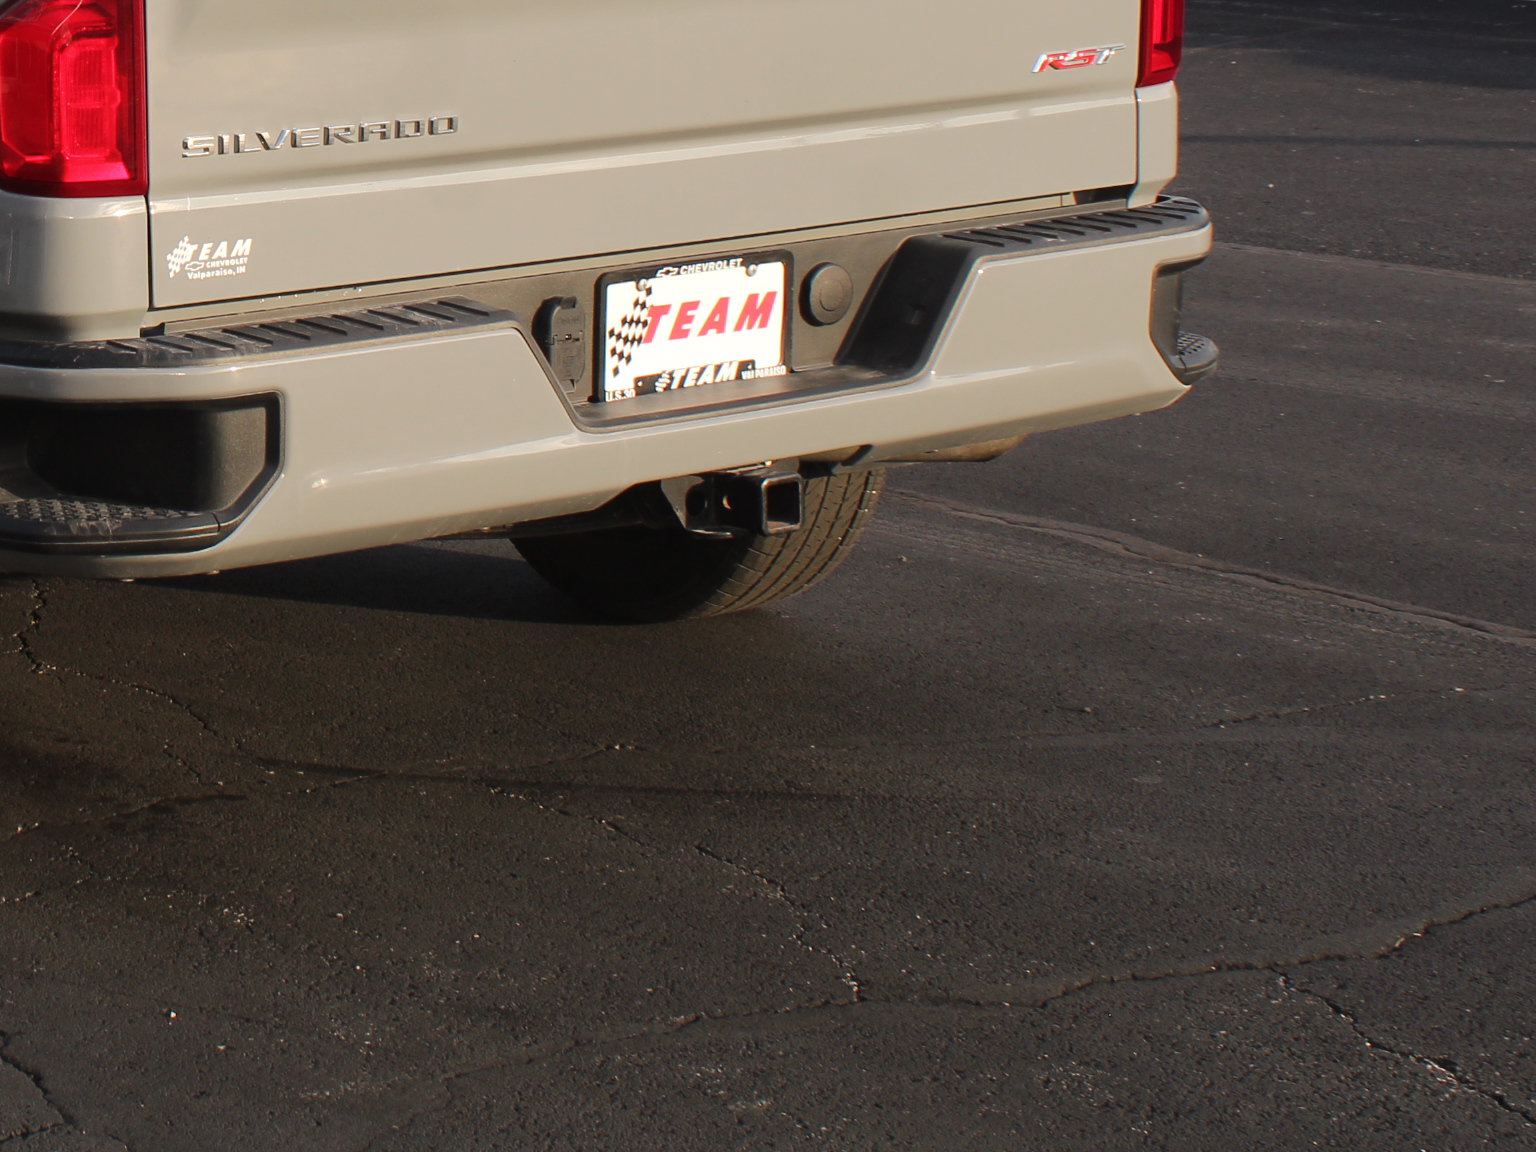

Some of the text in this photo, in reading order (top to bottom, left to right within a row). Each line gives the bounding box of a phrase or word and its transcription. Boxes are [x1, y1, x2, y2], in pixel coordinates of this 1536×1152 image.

[1031, 43, 1126, 73] RST
[181, 114, 459, 159] SILVERADO
[181, 239, 252, 262] TEAM
[206, 257, 248, 268] CHEVROLET
[679, 258, 744, 276] CHEVROLET
[643, 291, 777, 343] TEAM
[670, 361, 740, 390] TEAM
[741, 364, 787, 380] VALPARAISO
